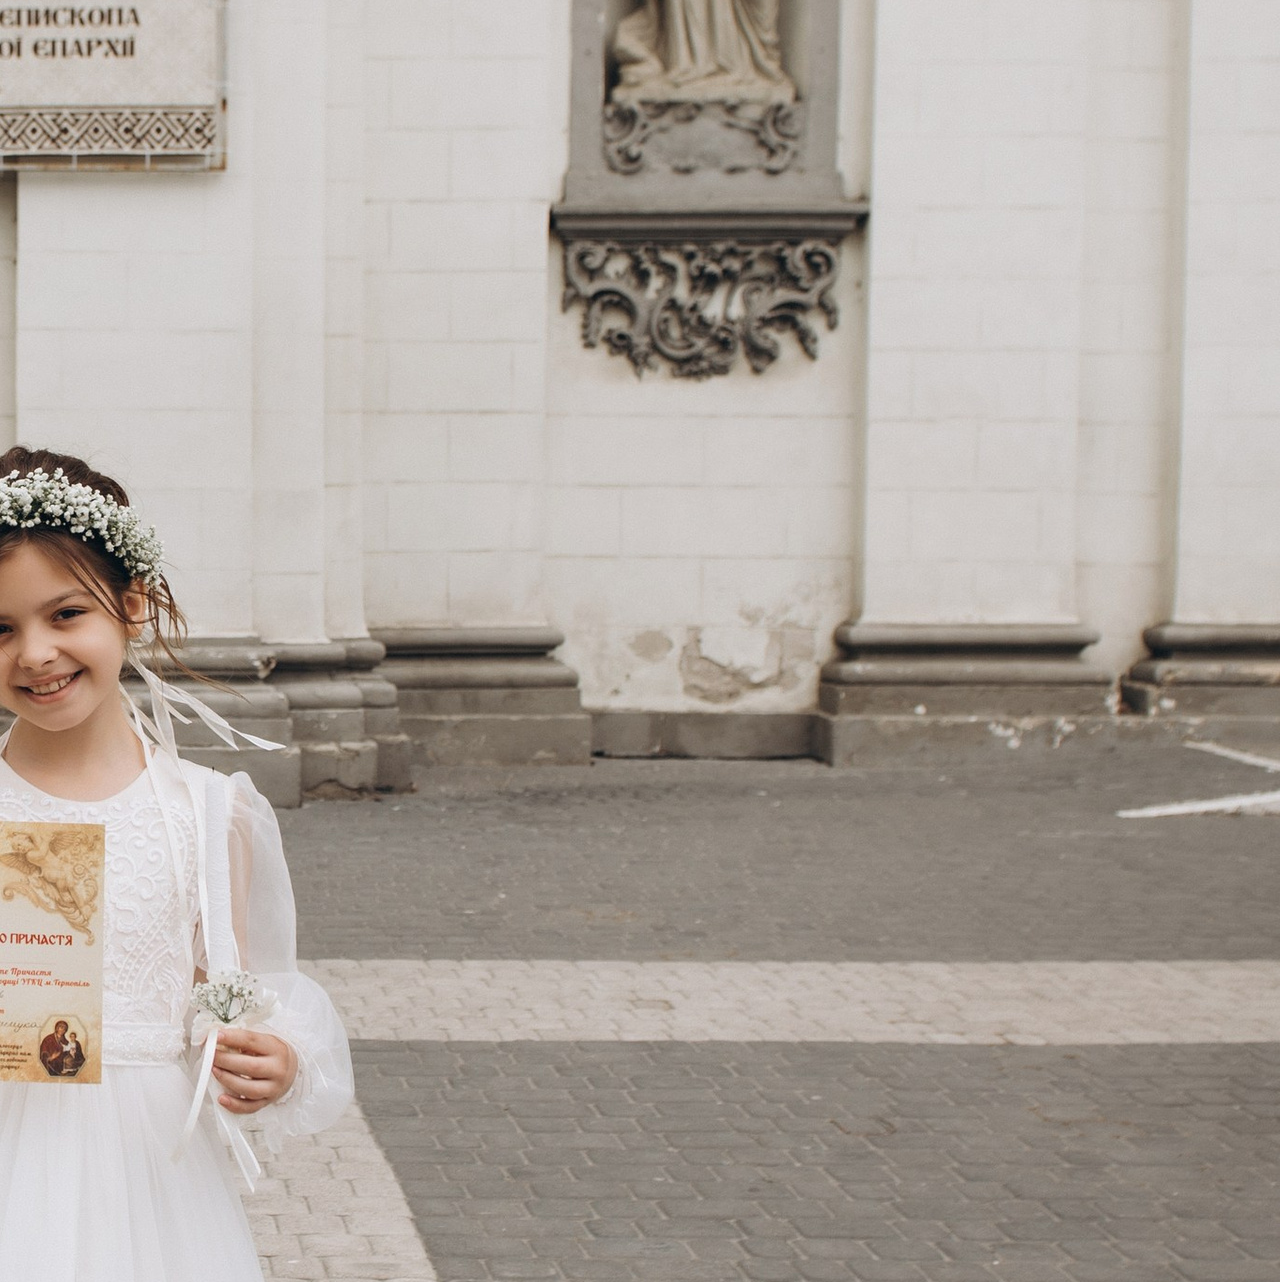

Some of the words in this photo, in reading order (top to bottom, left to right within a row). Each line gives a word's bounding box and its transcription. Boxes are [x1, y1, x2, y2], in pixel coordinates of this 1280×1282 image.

[32, 34, 135, 58] ЄПАРХІЇ
[10, 933, 73, 946] ПРИЧАСТЯ
[10, 967, 52, 977] Причастя
